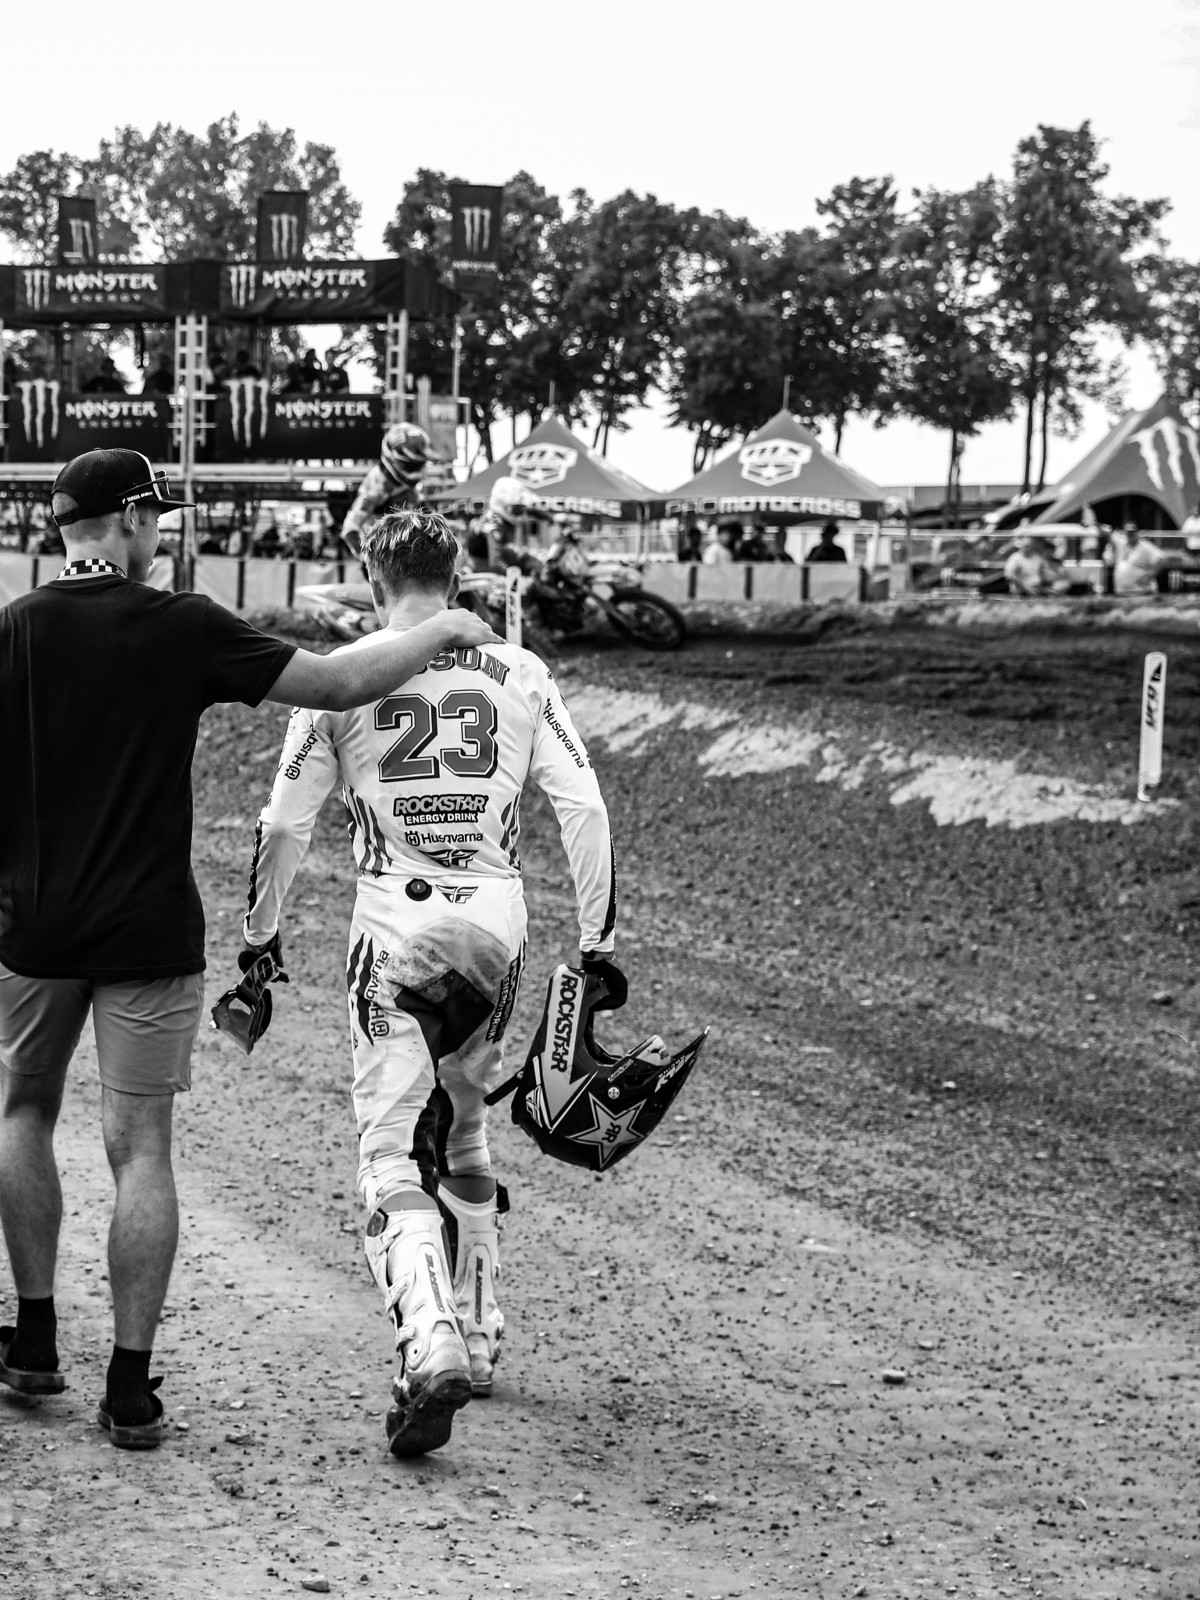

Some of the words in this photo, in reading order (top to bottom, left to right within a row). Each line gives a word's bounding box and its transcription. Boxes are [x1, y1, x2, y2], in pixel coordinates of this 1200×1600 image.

[55, 270, 158, 293] MONSTER
[262, 266, 367, 289] MONSTER
[65, 399, 158, 419] MONSTER
[275, 399, 372, 419] MONSTER
[375, 690, 498, 782] 23
[543, 706, 585, 768] Husqvarna
[394, 795, 488, 816] ROCKSTAR
[406, 813, 445, 825] ENERGY
[447, 812, 477, 822] DRINK
[421, 832, 483, 845] Husqvarna
[551, 974, 578, 1073] ROCKSTAR
